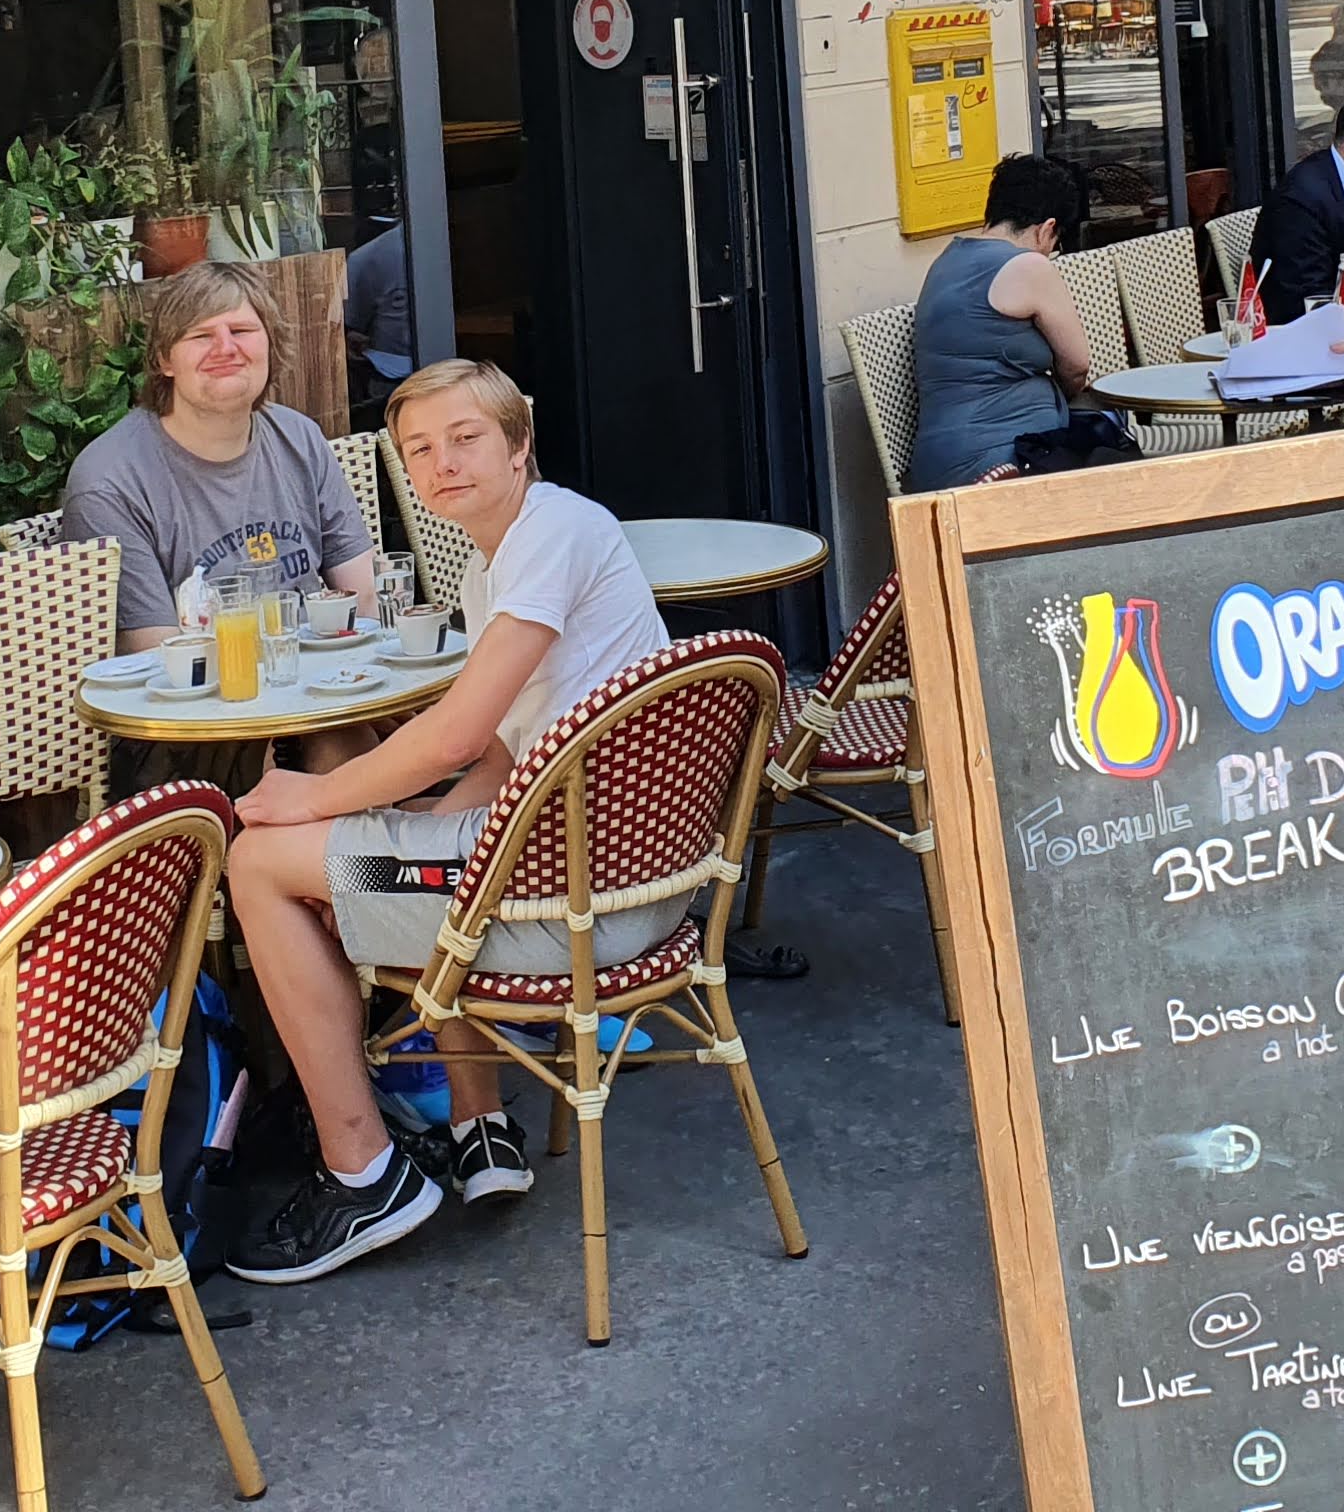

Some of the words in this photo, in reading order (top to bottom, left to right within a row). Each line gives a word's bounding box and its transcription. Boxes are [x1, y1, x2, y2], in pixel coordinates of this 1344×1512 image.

[246, 532, 278, 561] 53
[1051, 1015, 1142, 1065] UNE
[1262, 1042, 1282, 1063] a
[1295, 1020, 1339, 1058] hot
[1083, 1225, 1169, 1271] UNE
[1286, 1251, 1308, 1275] a
[1116, 1368, 1213, 1408] UNE
[1301, 1385, 1323, 1409] a
